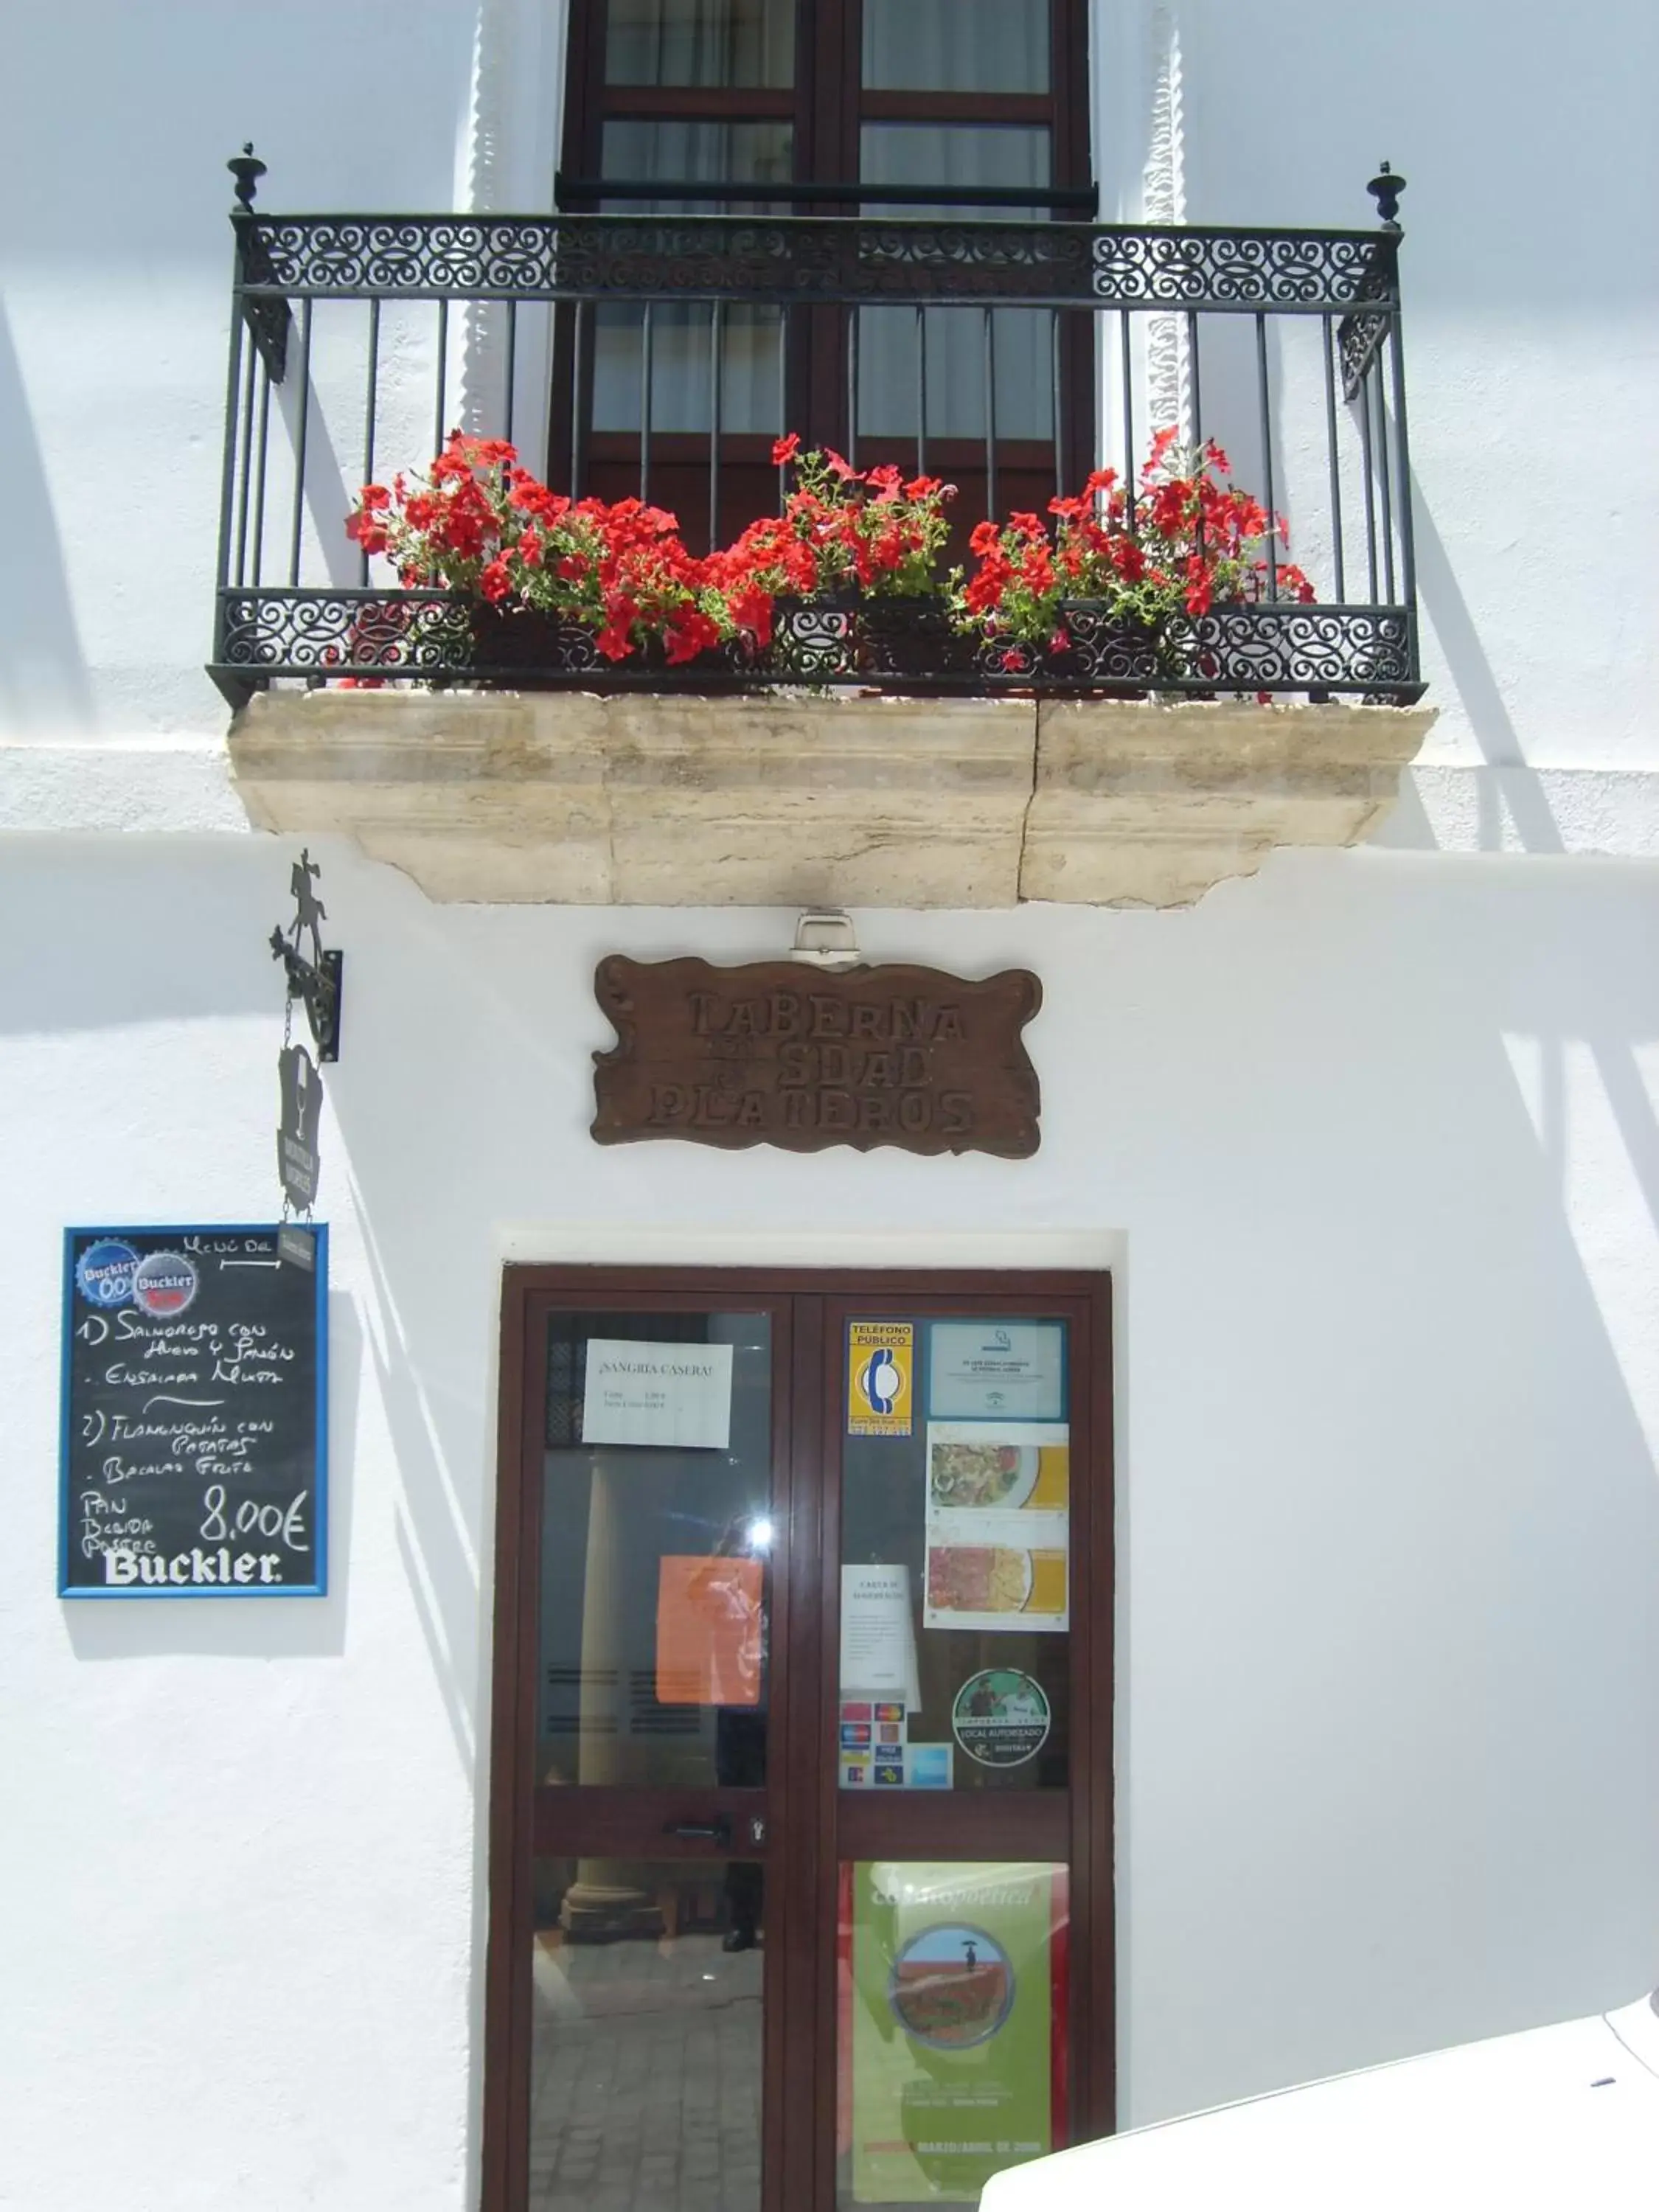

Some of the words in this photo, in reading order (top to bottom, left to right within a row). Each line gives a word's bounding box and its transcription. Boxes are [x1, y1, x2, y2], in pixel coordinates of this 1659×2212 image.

[686, 990, 966, 1041] TABERNA
[776, 1040, 935, 1090] SDAD
[646, 1082, 976, 1134] PLATEROS
[84, 1261, 137, 1281] Buckler
[139, 1276, 193, 1290] Buckler
[80, 1491, 126, 1516] PAN
